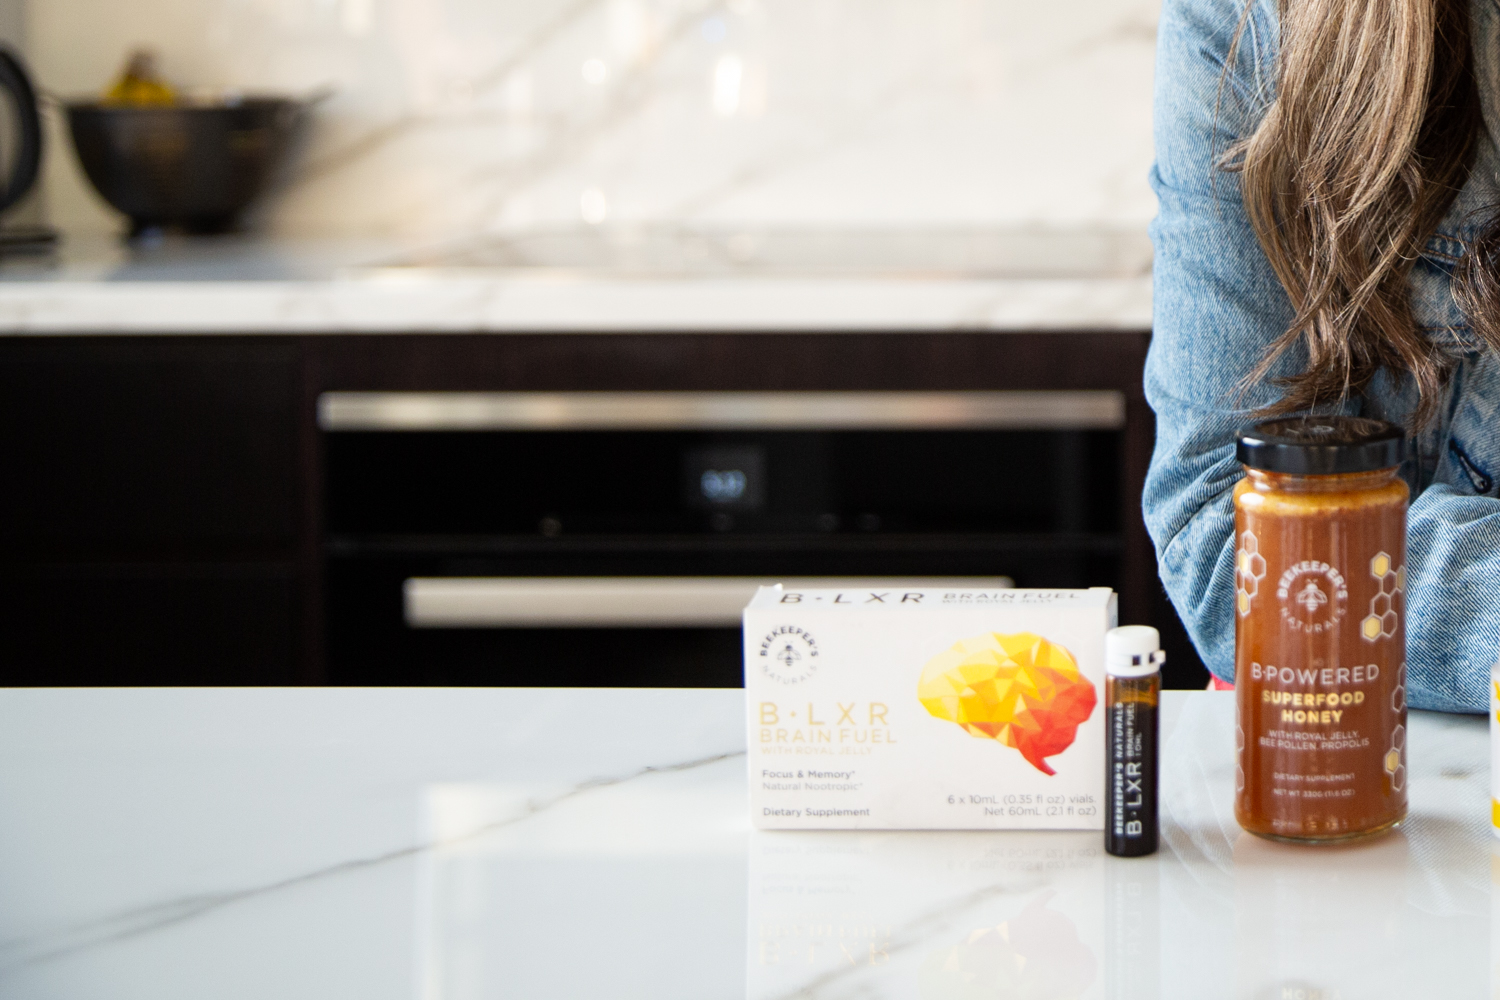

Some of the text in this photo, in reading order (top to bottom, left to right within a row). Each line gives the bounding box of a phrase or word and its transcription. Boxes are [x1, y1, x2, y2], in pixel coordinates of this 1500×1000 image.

[1277, 560, 1348, 599] BEEKEEPER'S
[1280, 606, 1346, 634] NATURALS
[760, 625, 819, 657] BEEKEEPER'S
[763, 663, 817, 685] NATURALS
[1262, 690, 1365, 706] SUPERFOOD
[1281, 709, 1343, 724] HONEY
[759, 728, 898, 744] BRAIN FUEL
[1126, 702, 1135, 758] BRAIN FUEL
[1269, 729, 1293, 739] WITH
[1294, 731, 1326, 741] ROYAL
[1259, 736, 1276, 747] BEE
[1321, 737, 1370, 750] PROPOLIS
[761, 746, 873, 756] WITH ROYAL JELLY
[762, 769, 794, 779] Focus
[797, 769, 804, 779] &
[1114, 702, 1124, 835] BEEKEEPER'S NATURALS
[1273, 772, 1355, 782] DIETARY SUPPLEMENT
[762, 782, 801, 791] Natural
[1273, 788, 1287, 797] NET
[947, 795, 956, 805] 6
[969, 795, 999, 805] 10mL
[1003, 795, 1033, 805] (0.35
[1036, 794, 1044, 804] fl
[1047, 795, 1066, 805] oz)
[763, 807, 870, 818] Dietary Supplement
[985, 806, 1098, 817] Net 60mL (2.1 fl oz)
